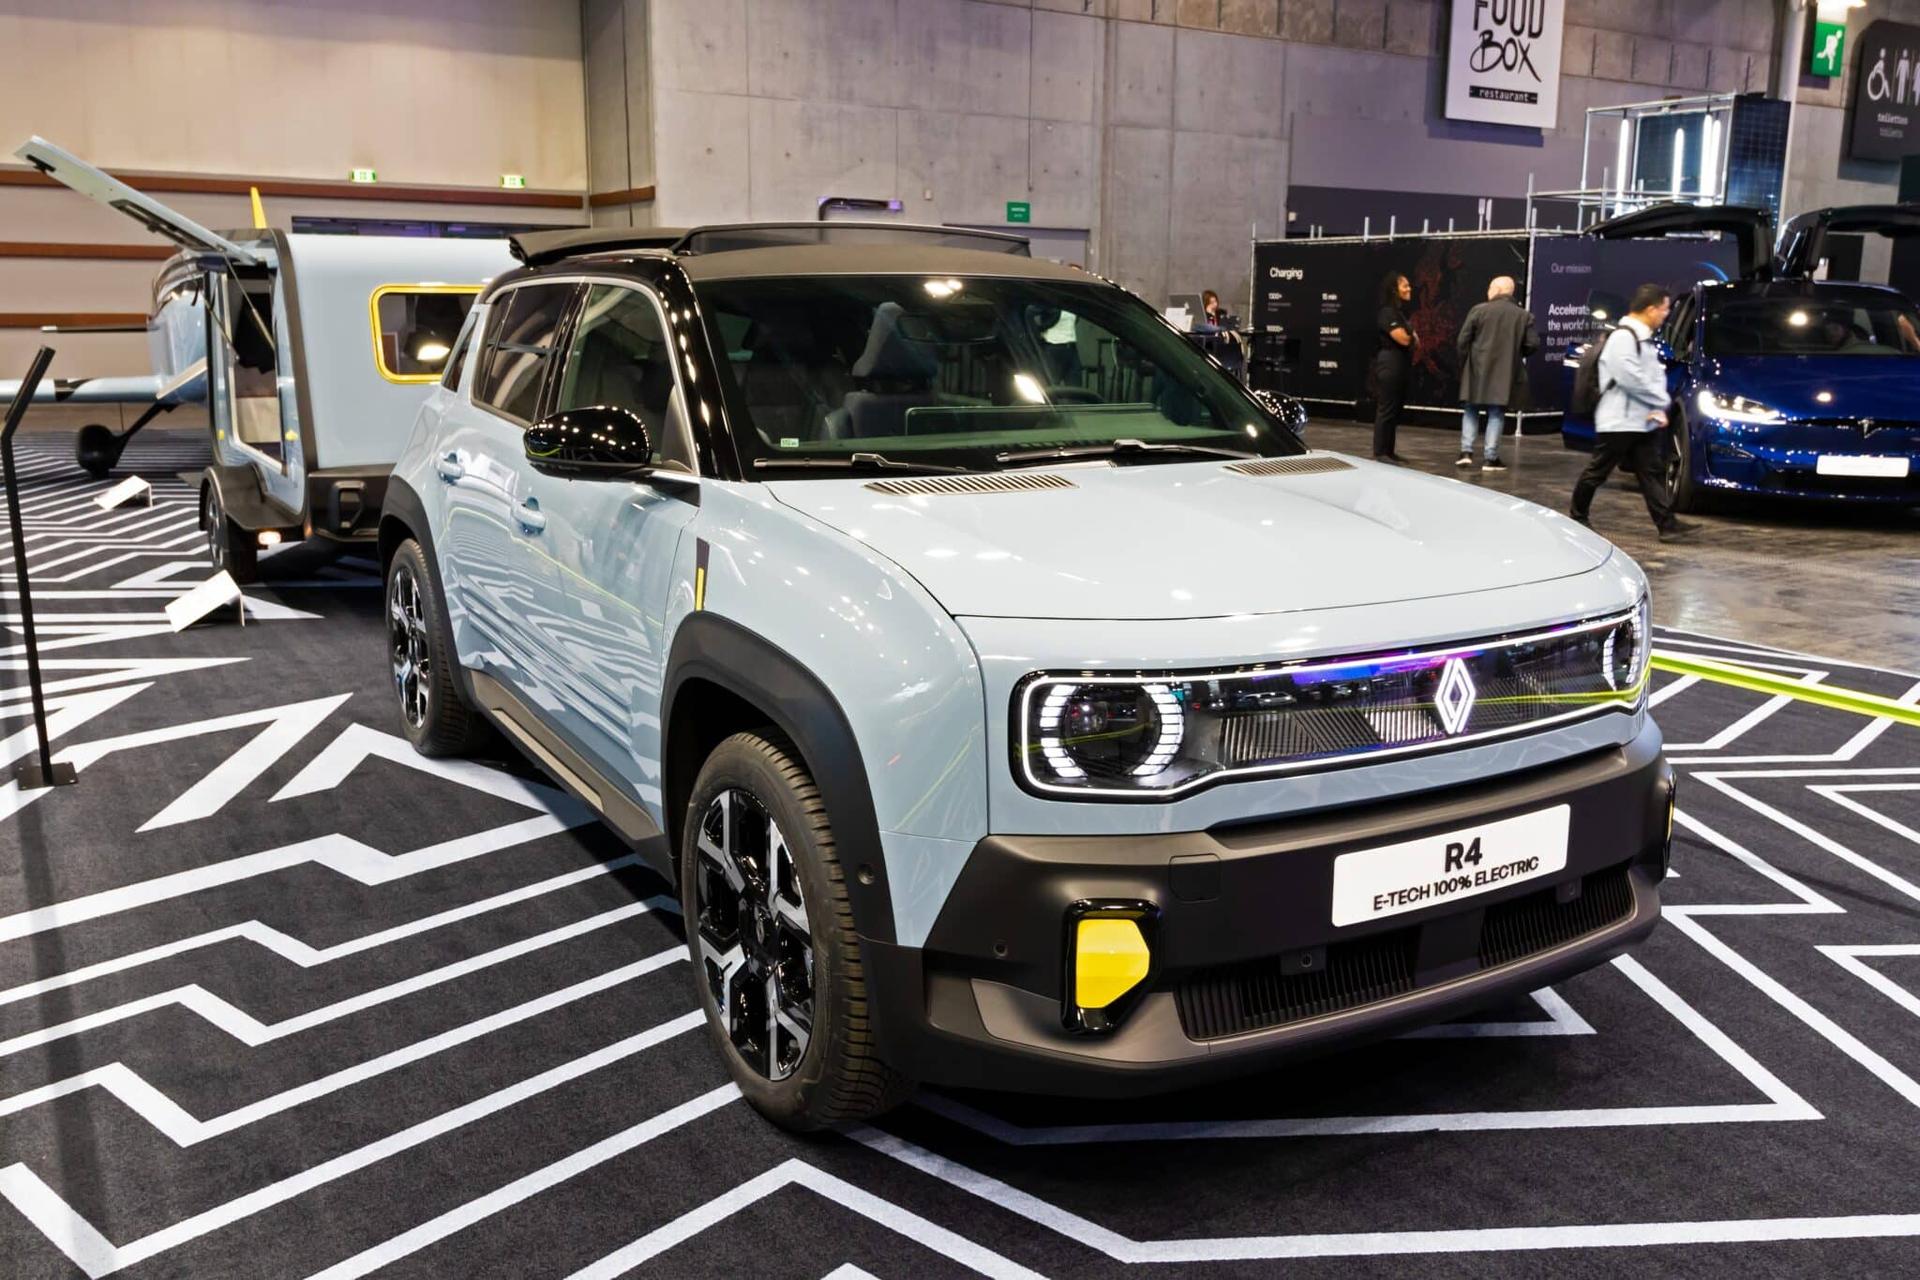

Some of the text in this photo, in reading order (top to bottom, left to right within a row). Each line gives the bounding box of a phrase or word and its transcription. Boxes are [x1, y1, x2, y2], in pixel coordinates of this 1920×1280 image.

[1479, 88, 1530, 102] restaurant
[1269, 266, 1304, 280] Charging
[1551, 262, 1592, 273] Our mission
[1547, 319, 1561, 331] the
[1444, 837, 1483, 873] R4
[1373, 856, 1540, 911] E-TECH 100% ELECTRIC
